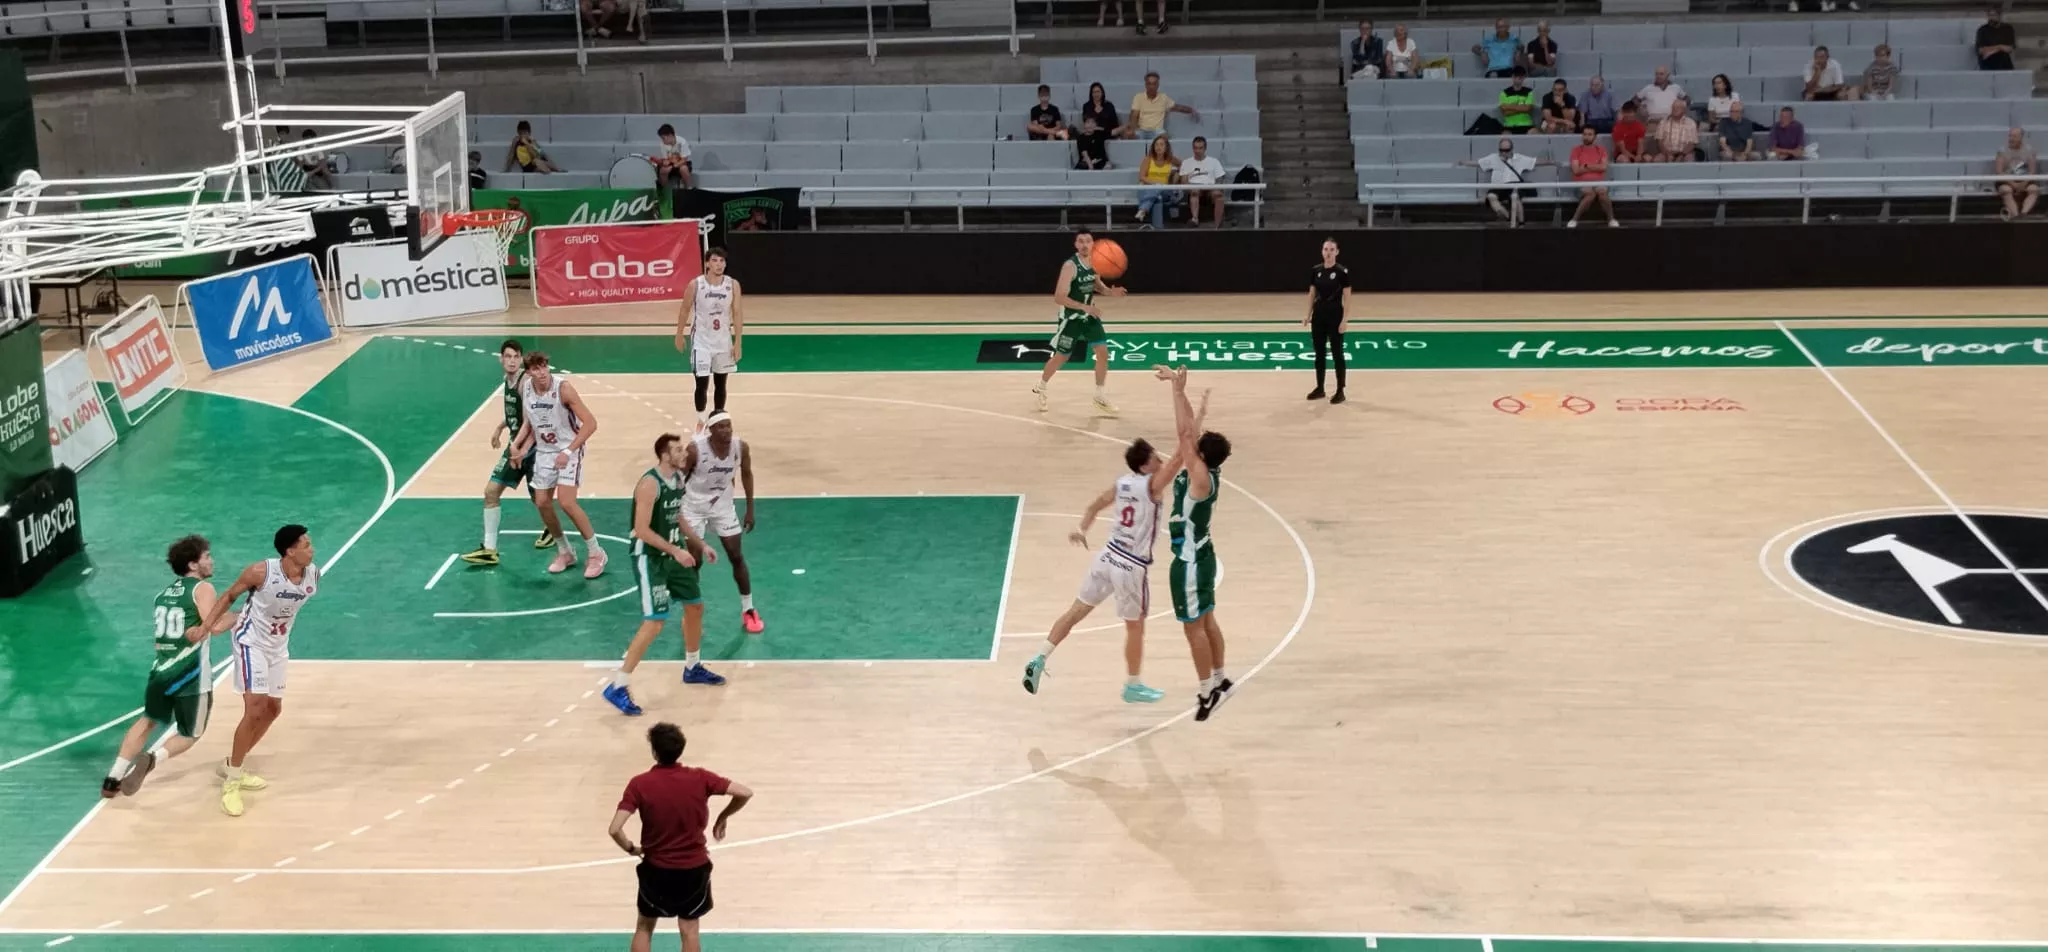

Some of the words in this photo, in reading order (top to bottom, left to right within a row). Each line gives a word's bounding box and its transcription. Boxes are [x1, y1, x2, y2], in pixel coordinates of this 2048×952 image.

[564, 234, 600, 245] GRUPO
[565, 254, 674, 280] Lobe
[578, 288, 598, 298] HIGH
[601, 287, 634, 298] QUALITY
[637, 286, 666, 296] HOMES
[234, 332, 303, 360] movicoders
[1105, 339, 1428, 352] Ayuntamnto
[1497, 340, 1783, 360] Hacemos
[112, 327, 169, 389] UNITIC
[17, 497, 76, 564] Huesca
